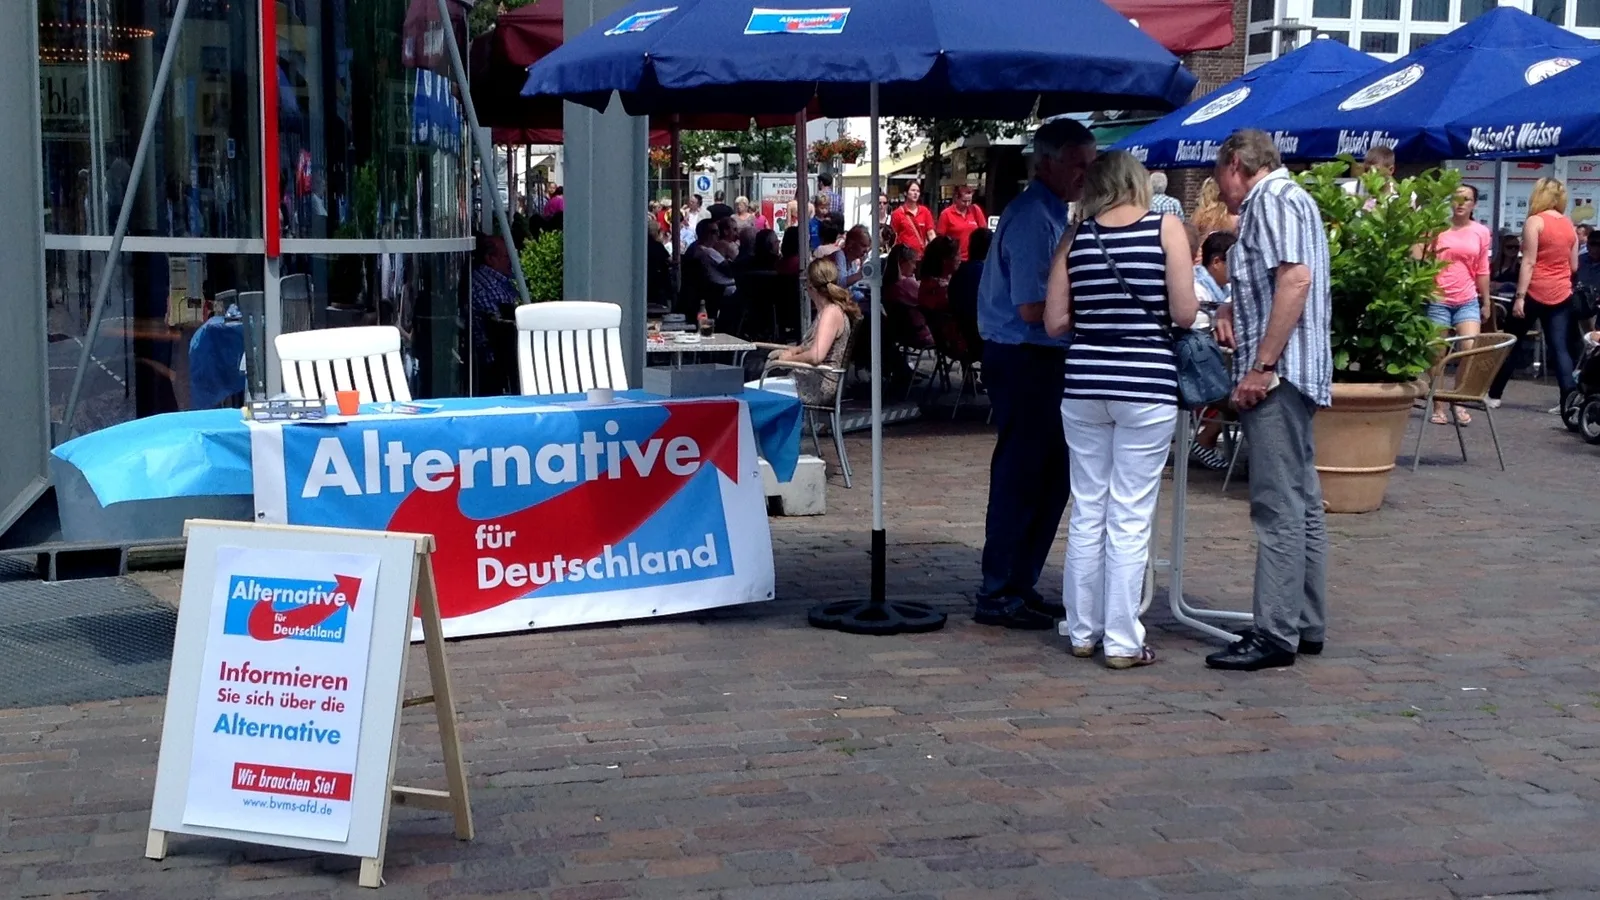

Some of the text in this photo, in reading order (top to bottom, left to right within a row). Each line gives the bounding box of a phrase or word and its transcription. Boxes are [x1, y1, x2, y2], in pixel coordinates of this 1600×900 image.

[1466, 120, 1562, 153] Maisel's Weisse
[301, 419, 701, 499] Alternative
[475, 524, 516, 550] für
[477, 532, 718, 590] Deutschland
[231, 579, 347, 607] Alternative
[273, 623, 343, 639] Deutschland
[274, 612, 287, 622] für
[219, 660, 348, 691] Informieren
[217, 687, 345, 713] Sie sich über die
[212, 712, 341, 745] Alternative
[237, 767, 337, 795] Wir brauchen Sie!
[242, 795, 333, 816] www.bvms-afd.de
